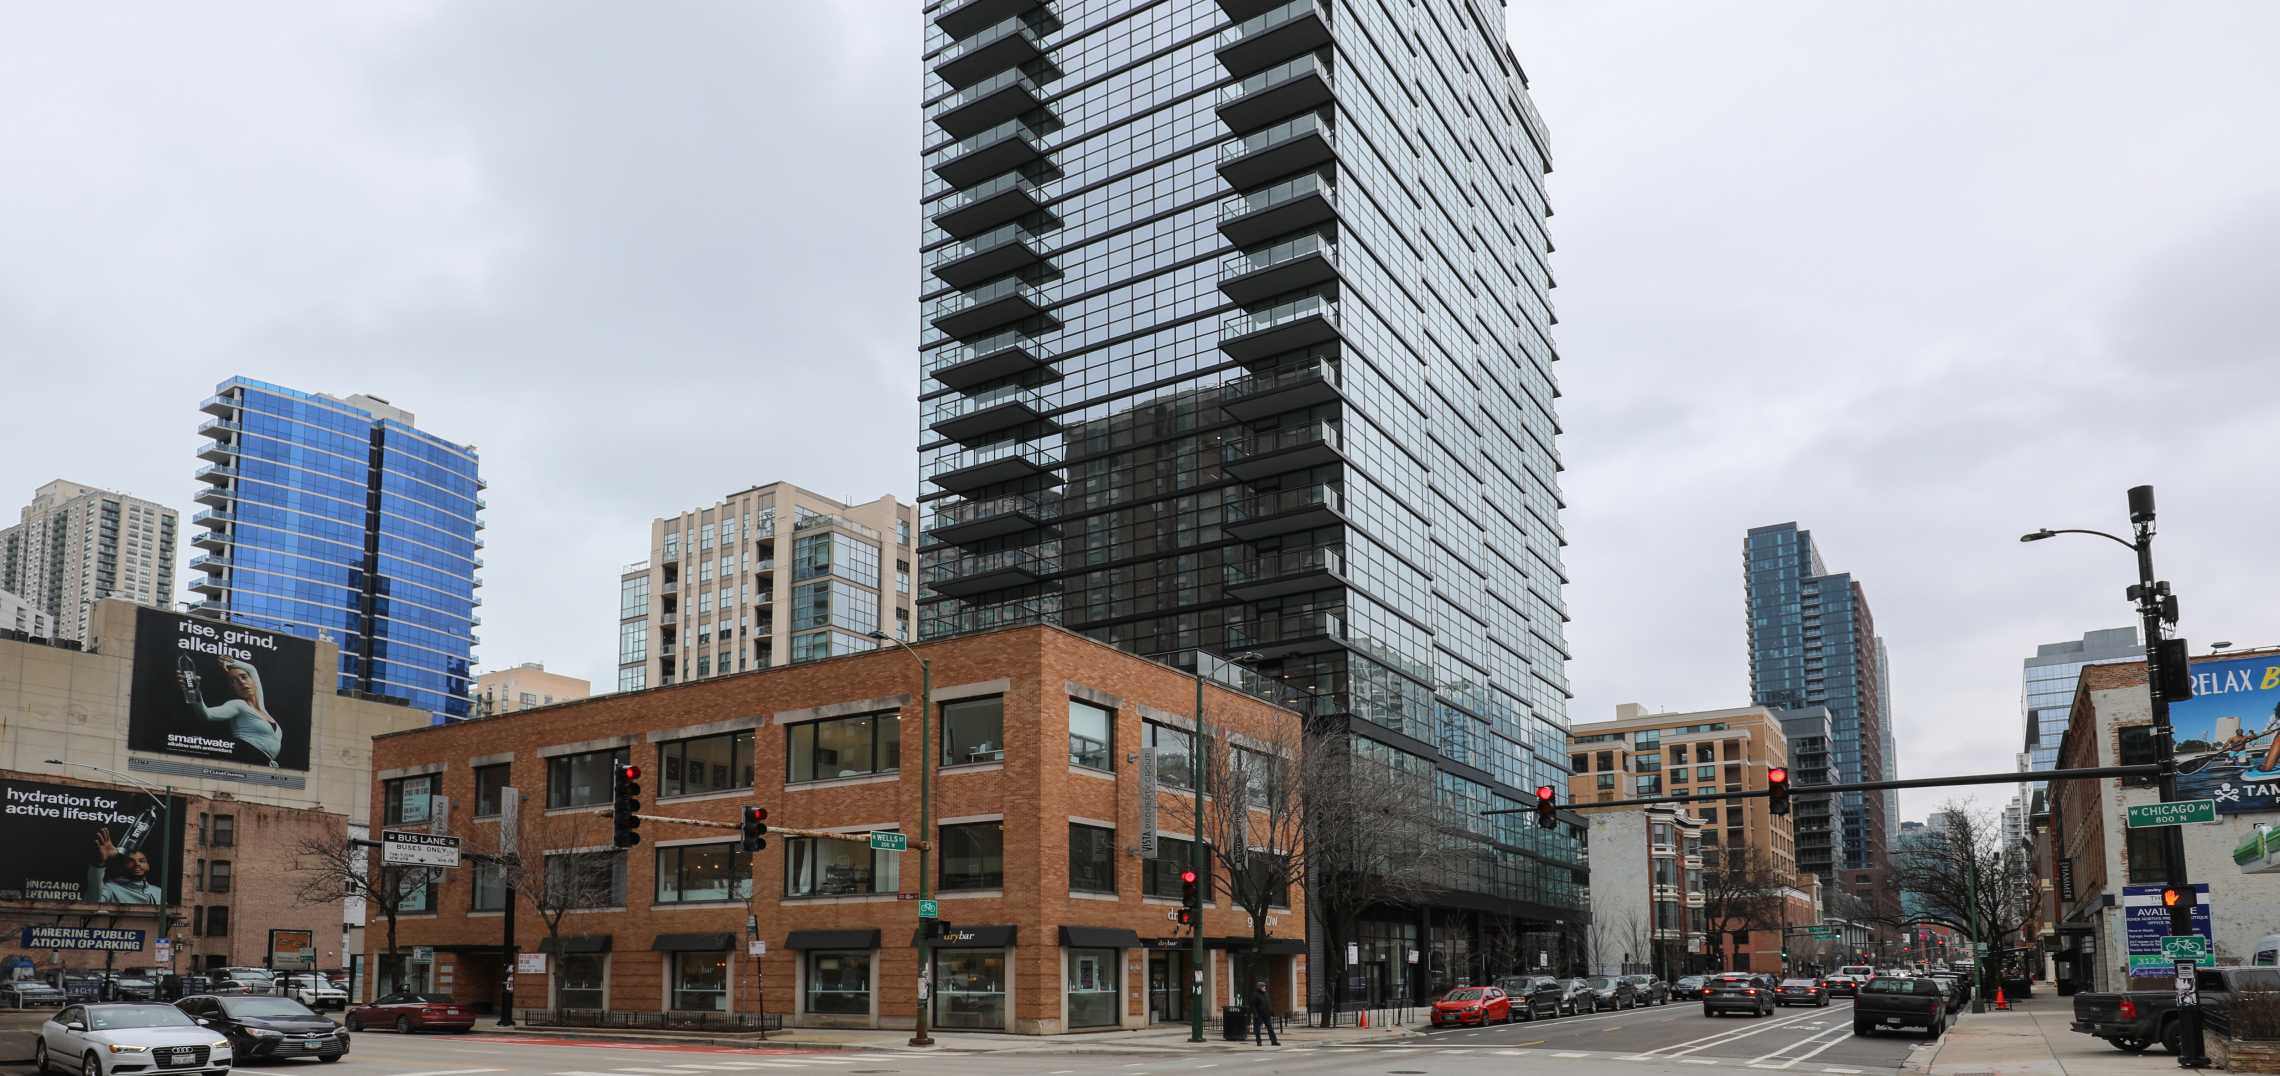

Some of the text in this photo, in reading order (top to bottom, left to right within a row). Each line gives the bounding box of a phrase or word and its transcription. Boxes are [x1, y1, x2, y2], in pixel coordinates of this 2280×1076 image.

[179, 620, 278, 651] rise, grind,
[178, 637, 252, 660] alkaline
[2191, 669, 2253, 696] RELAX
[167, 734, 235, 749] smartwater
[7, 787, 117, 809] hydration for
[5, 803, 136, 824] active lifestyles
[2141, 803, 2195, 816] CHICAGO
[2199, 803, 2210, 811] AV
[2155, 815, 2175, 824] 800
[397, 833, 446, 846] BUS LANE
[877, 834, 898, 843] WELLS
[396, 843, 447, 854] BUSES ONLY
[93, 929, 137, 940] PUBLIC
